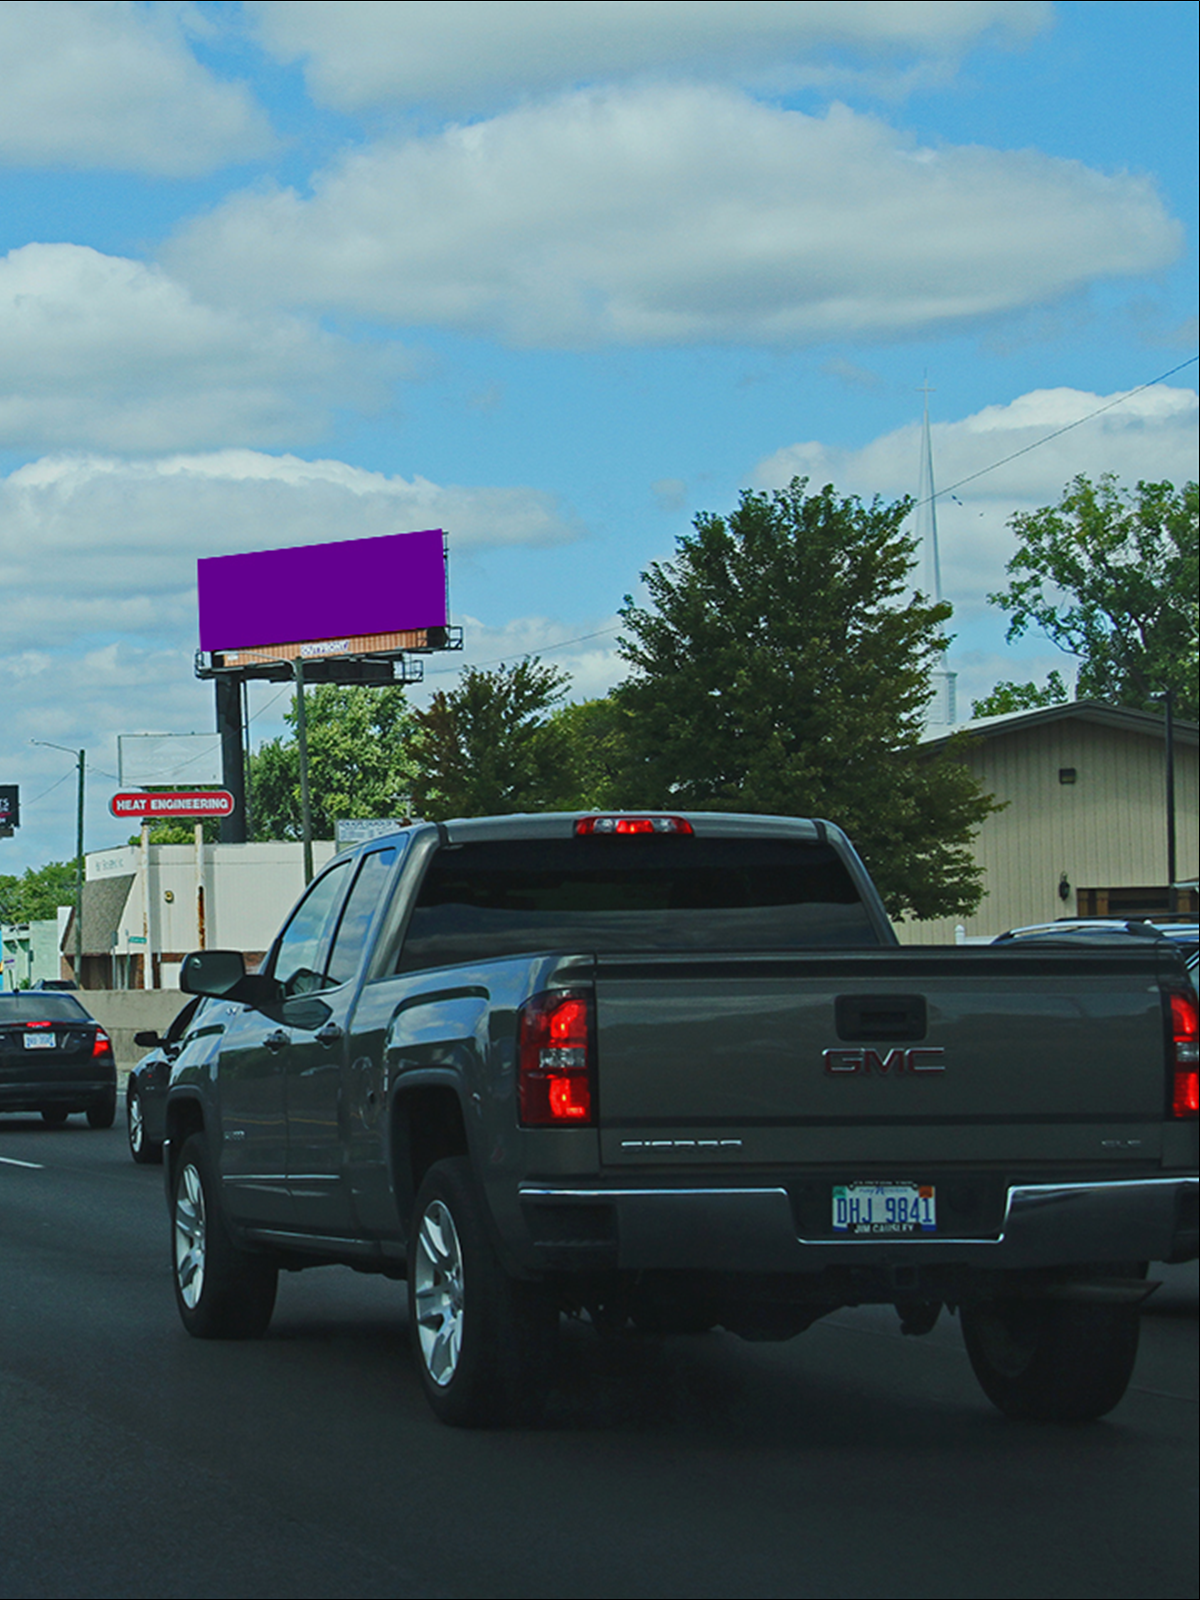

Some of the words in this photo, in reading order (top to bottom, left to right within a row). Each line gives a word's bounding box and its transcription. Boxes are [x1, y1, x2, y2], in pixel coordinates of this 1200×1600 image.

[116, 799, 147, 811] HEAT
[150, 798, 229, 810] ENGINEERING
[821, 1047, 946, 1074] GMC
[837, 1197, 872, 1224] DHJ
[885, 1197, 933, 1224] 9841
